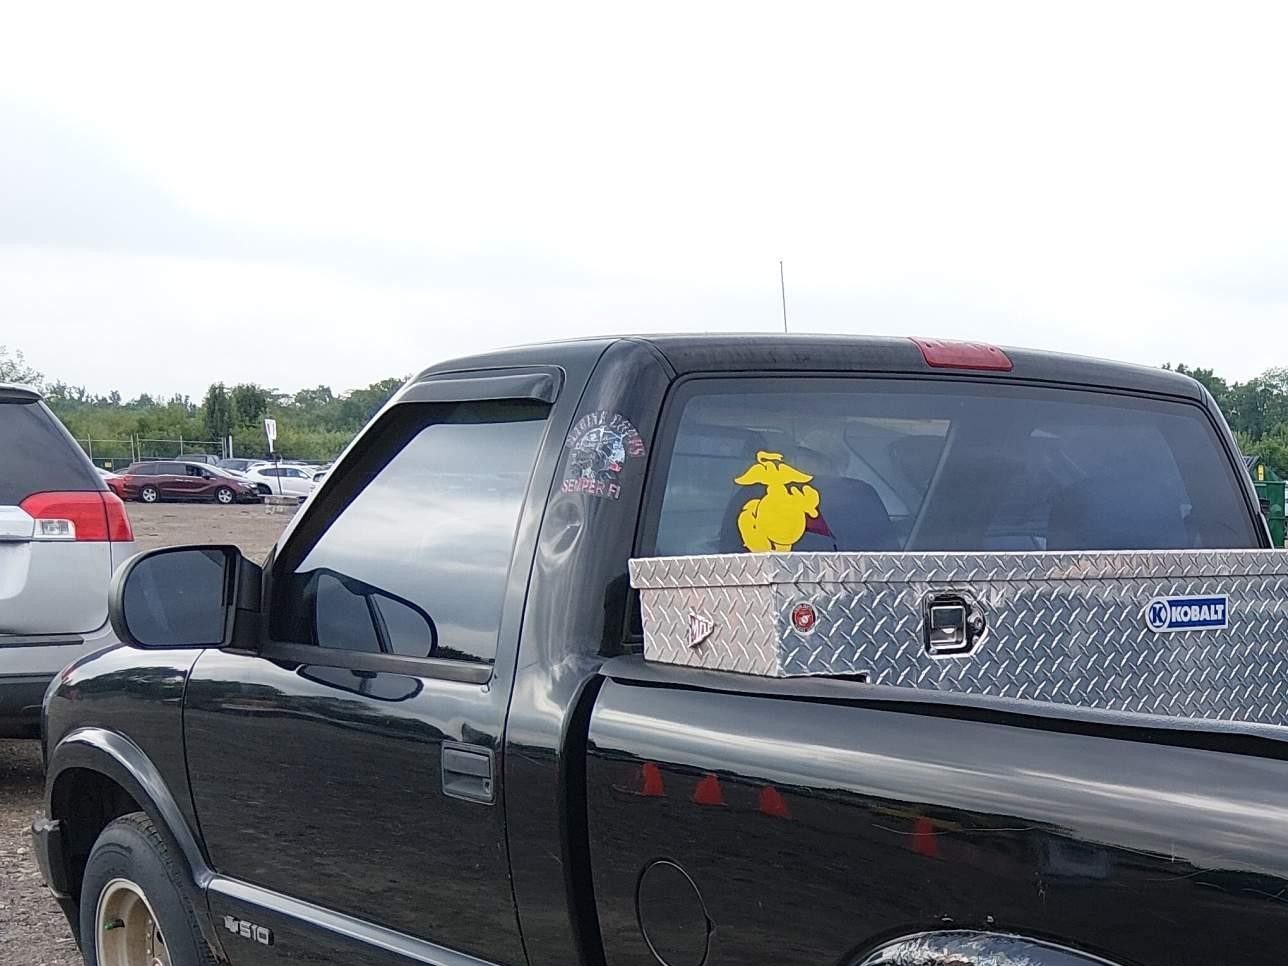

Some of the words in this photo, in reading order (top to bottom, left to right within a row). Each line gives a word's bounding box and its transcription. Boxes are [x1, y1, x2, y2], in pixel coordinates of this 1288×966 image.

[561, 477, 606, 496] SEMPER
[607, 483, 621, 499] FI
[1171, 604, 1225, 622] KOBALT
[240, 920, 269, 945] S10
